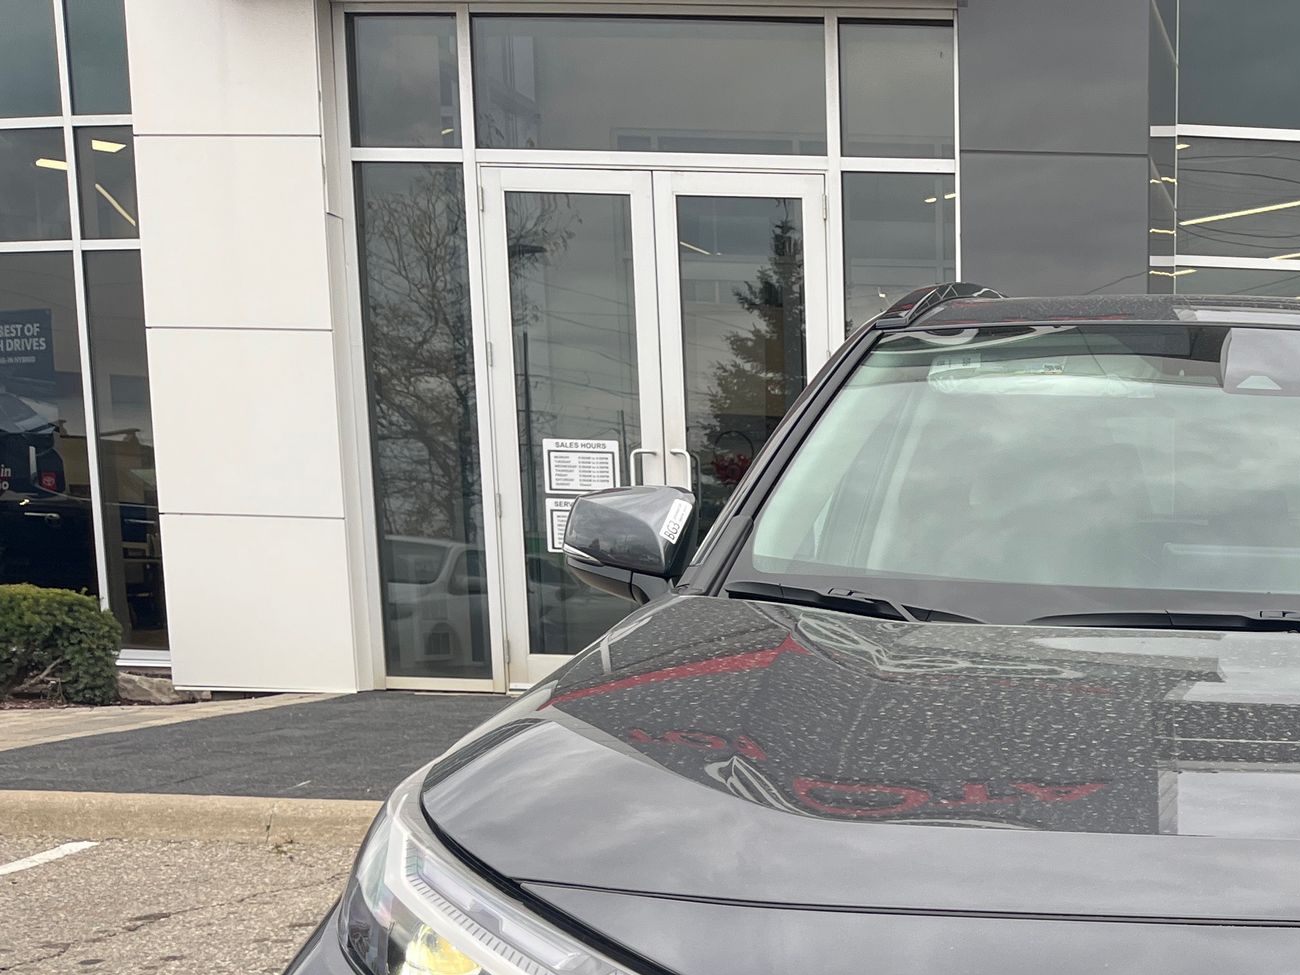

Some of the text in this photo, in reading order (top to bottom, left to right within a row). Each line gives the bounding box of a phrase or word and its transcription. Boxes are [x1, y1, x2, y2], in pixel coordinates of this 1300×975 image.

[24, 323, 40, 336] OF
[6, 338, 47, 351] DRIVES
[580, 442, 607, 450] HOURS
